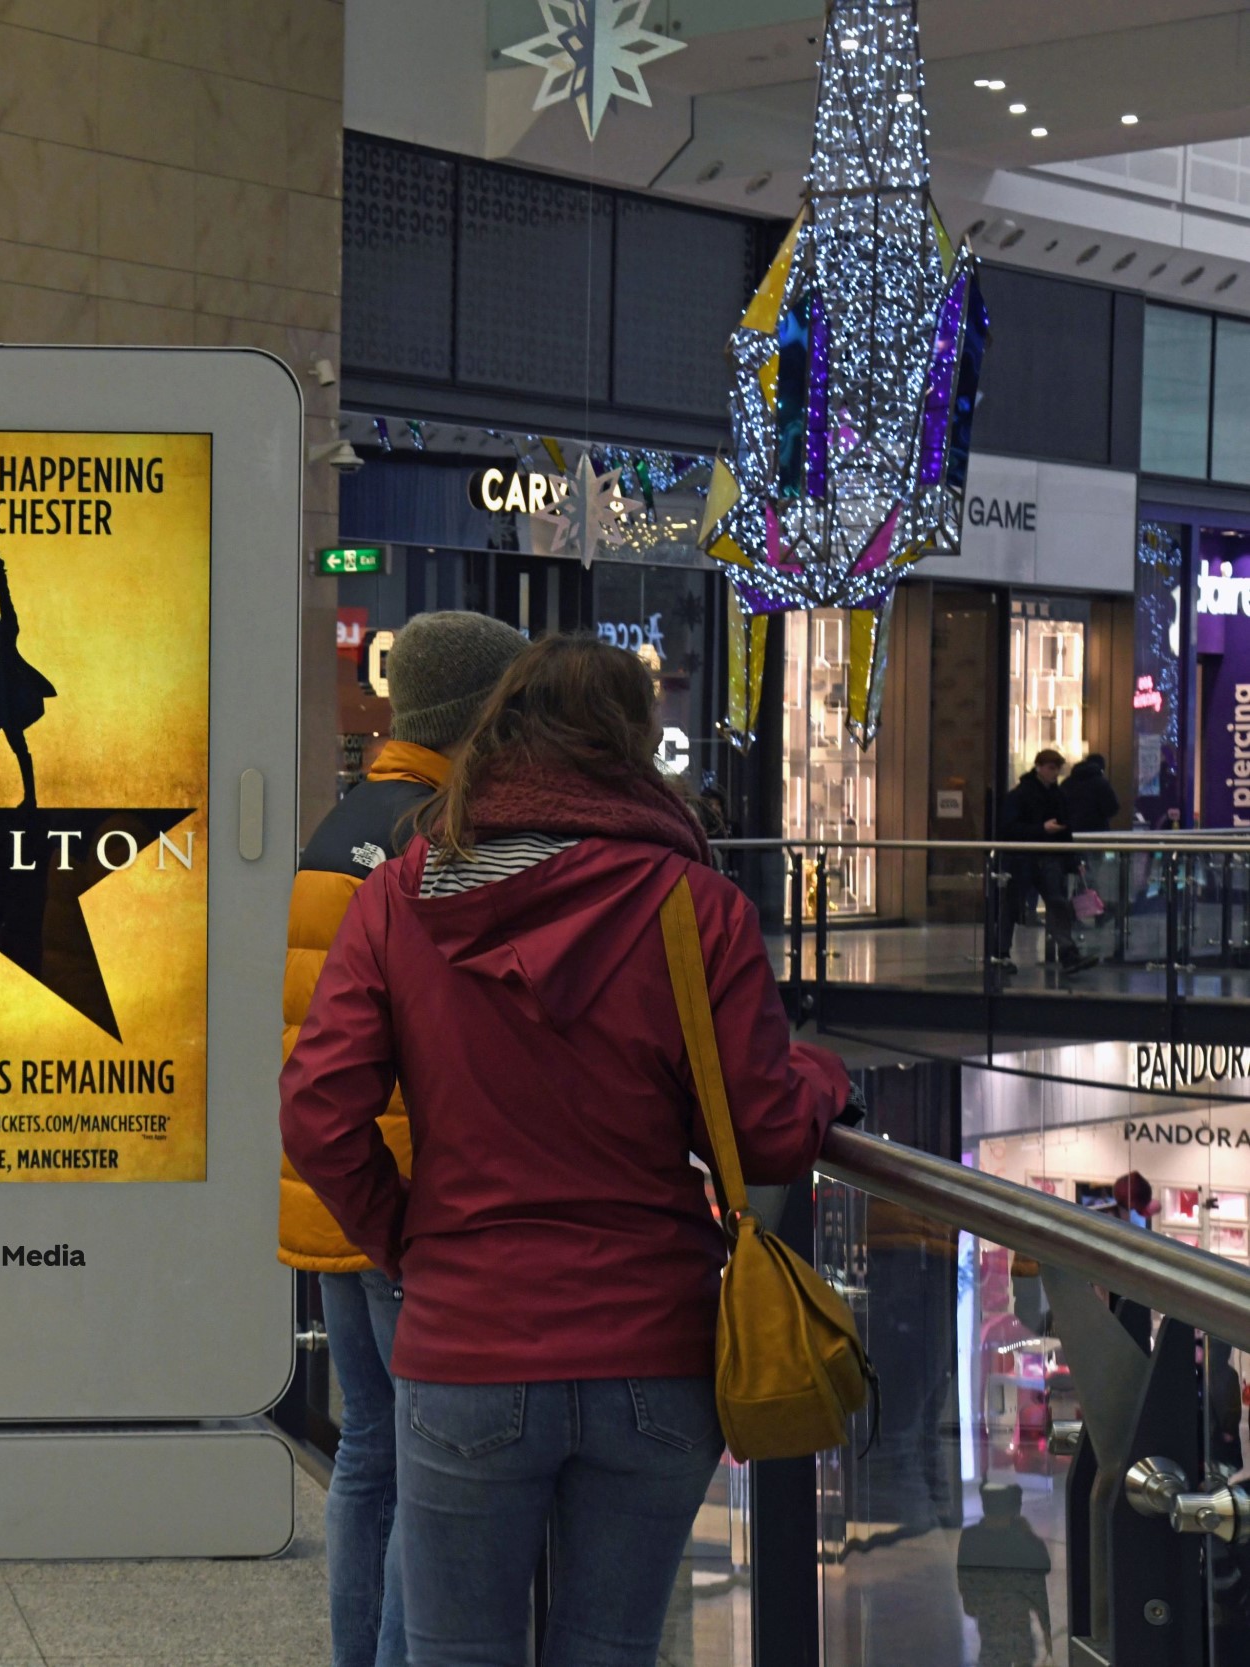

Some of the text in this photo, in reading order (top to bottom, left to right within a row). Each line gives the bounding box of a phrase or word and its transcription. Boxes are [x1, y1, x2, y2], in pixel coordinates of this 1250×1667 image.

[968, 496, 1037, 532] GAME
[359, 555, 376, 566] Exit
[22, 1060, 175, 1095] REMAINING
[1136, 1040, 1250, 1089] PANDOR
[1124, 1120, 1250, 1147] PANDORA
[17, 1149, 119, 1169] MANCHESTER
[2, 1243, 86, 1266] Media
